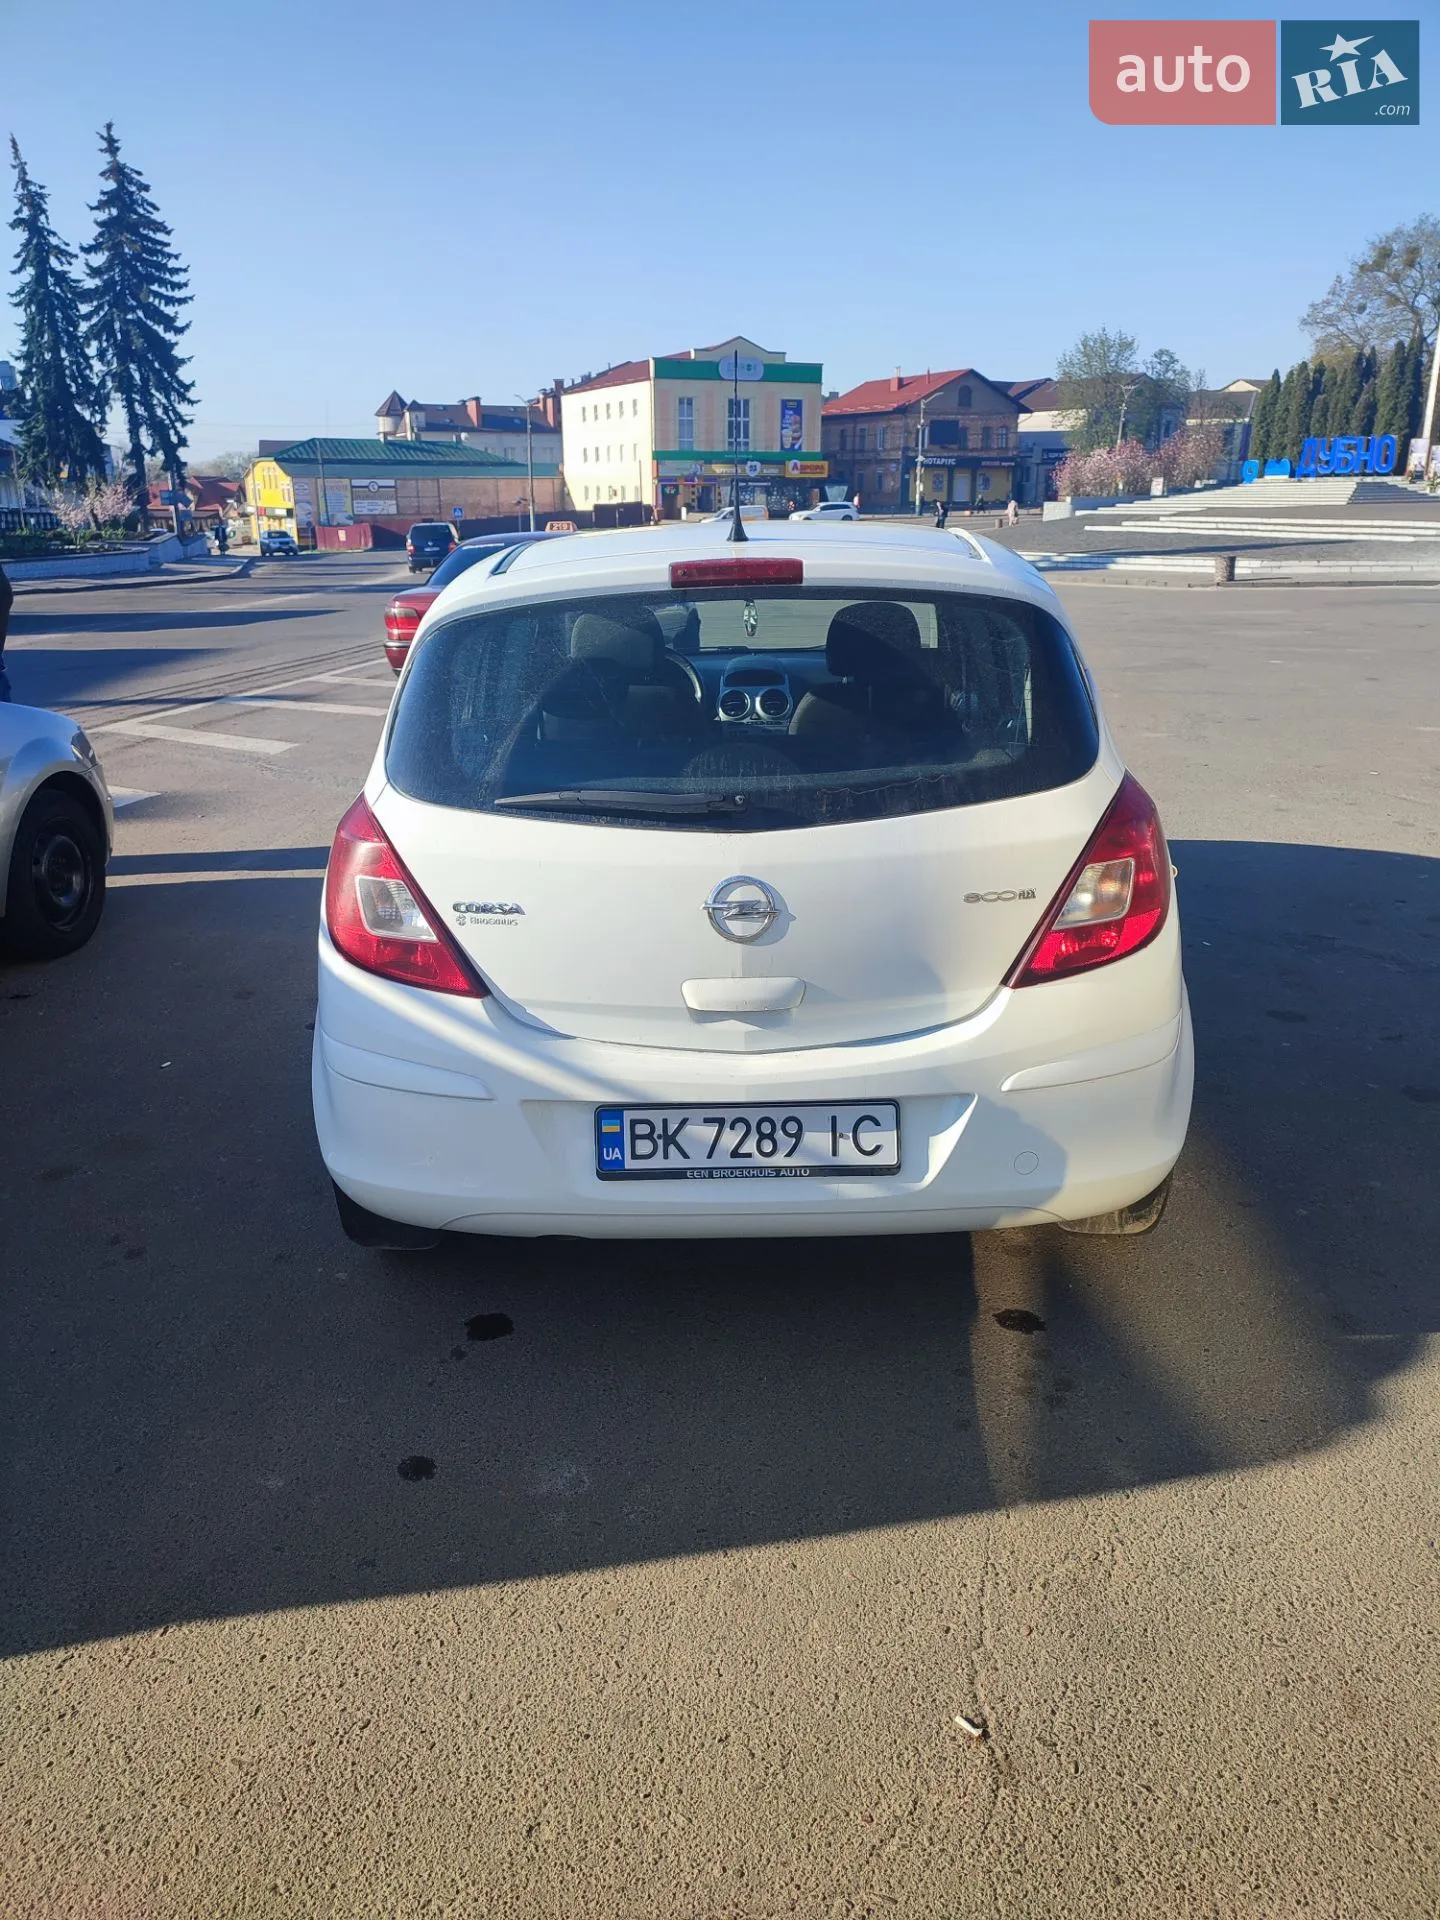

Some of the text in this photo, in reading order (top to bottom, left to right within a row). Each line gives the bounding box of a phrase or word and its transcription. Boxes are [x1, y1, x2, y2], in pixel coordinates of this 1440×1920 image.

[1295, 433, 1398, 480] ДУБНО
[452, 901, 526, 916] CORSA
[629, 1114, 883, 1160] BK 7289 IC
[603, 1147, 623, 1161] UA
[686, 1167, 810, 1179] EEN BROEKHUIS AUTO
